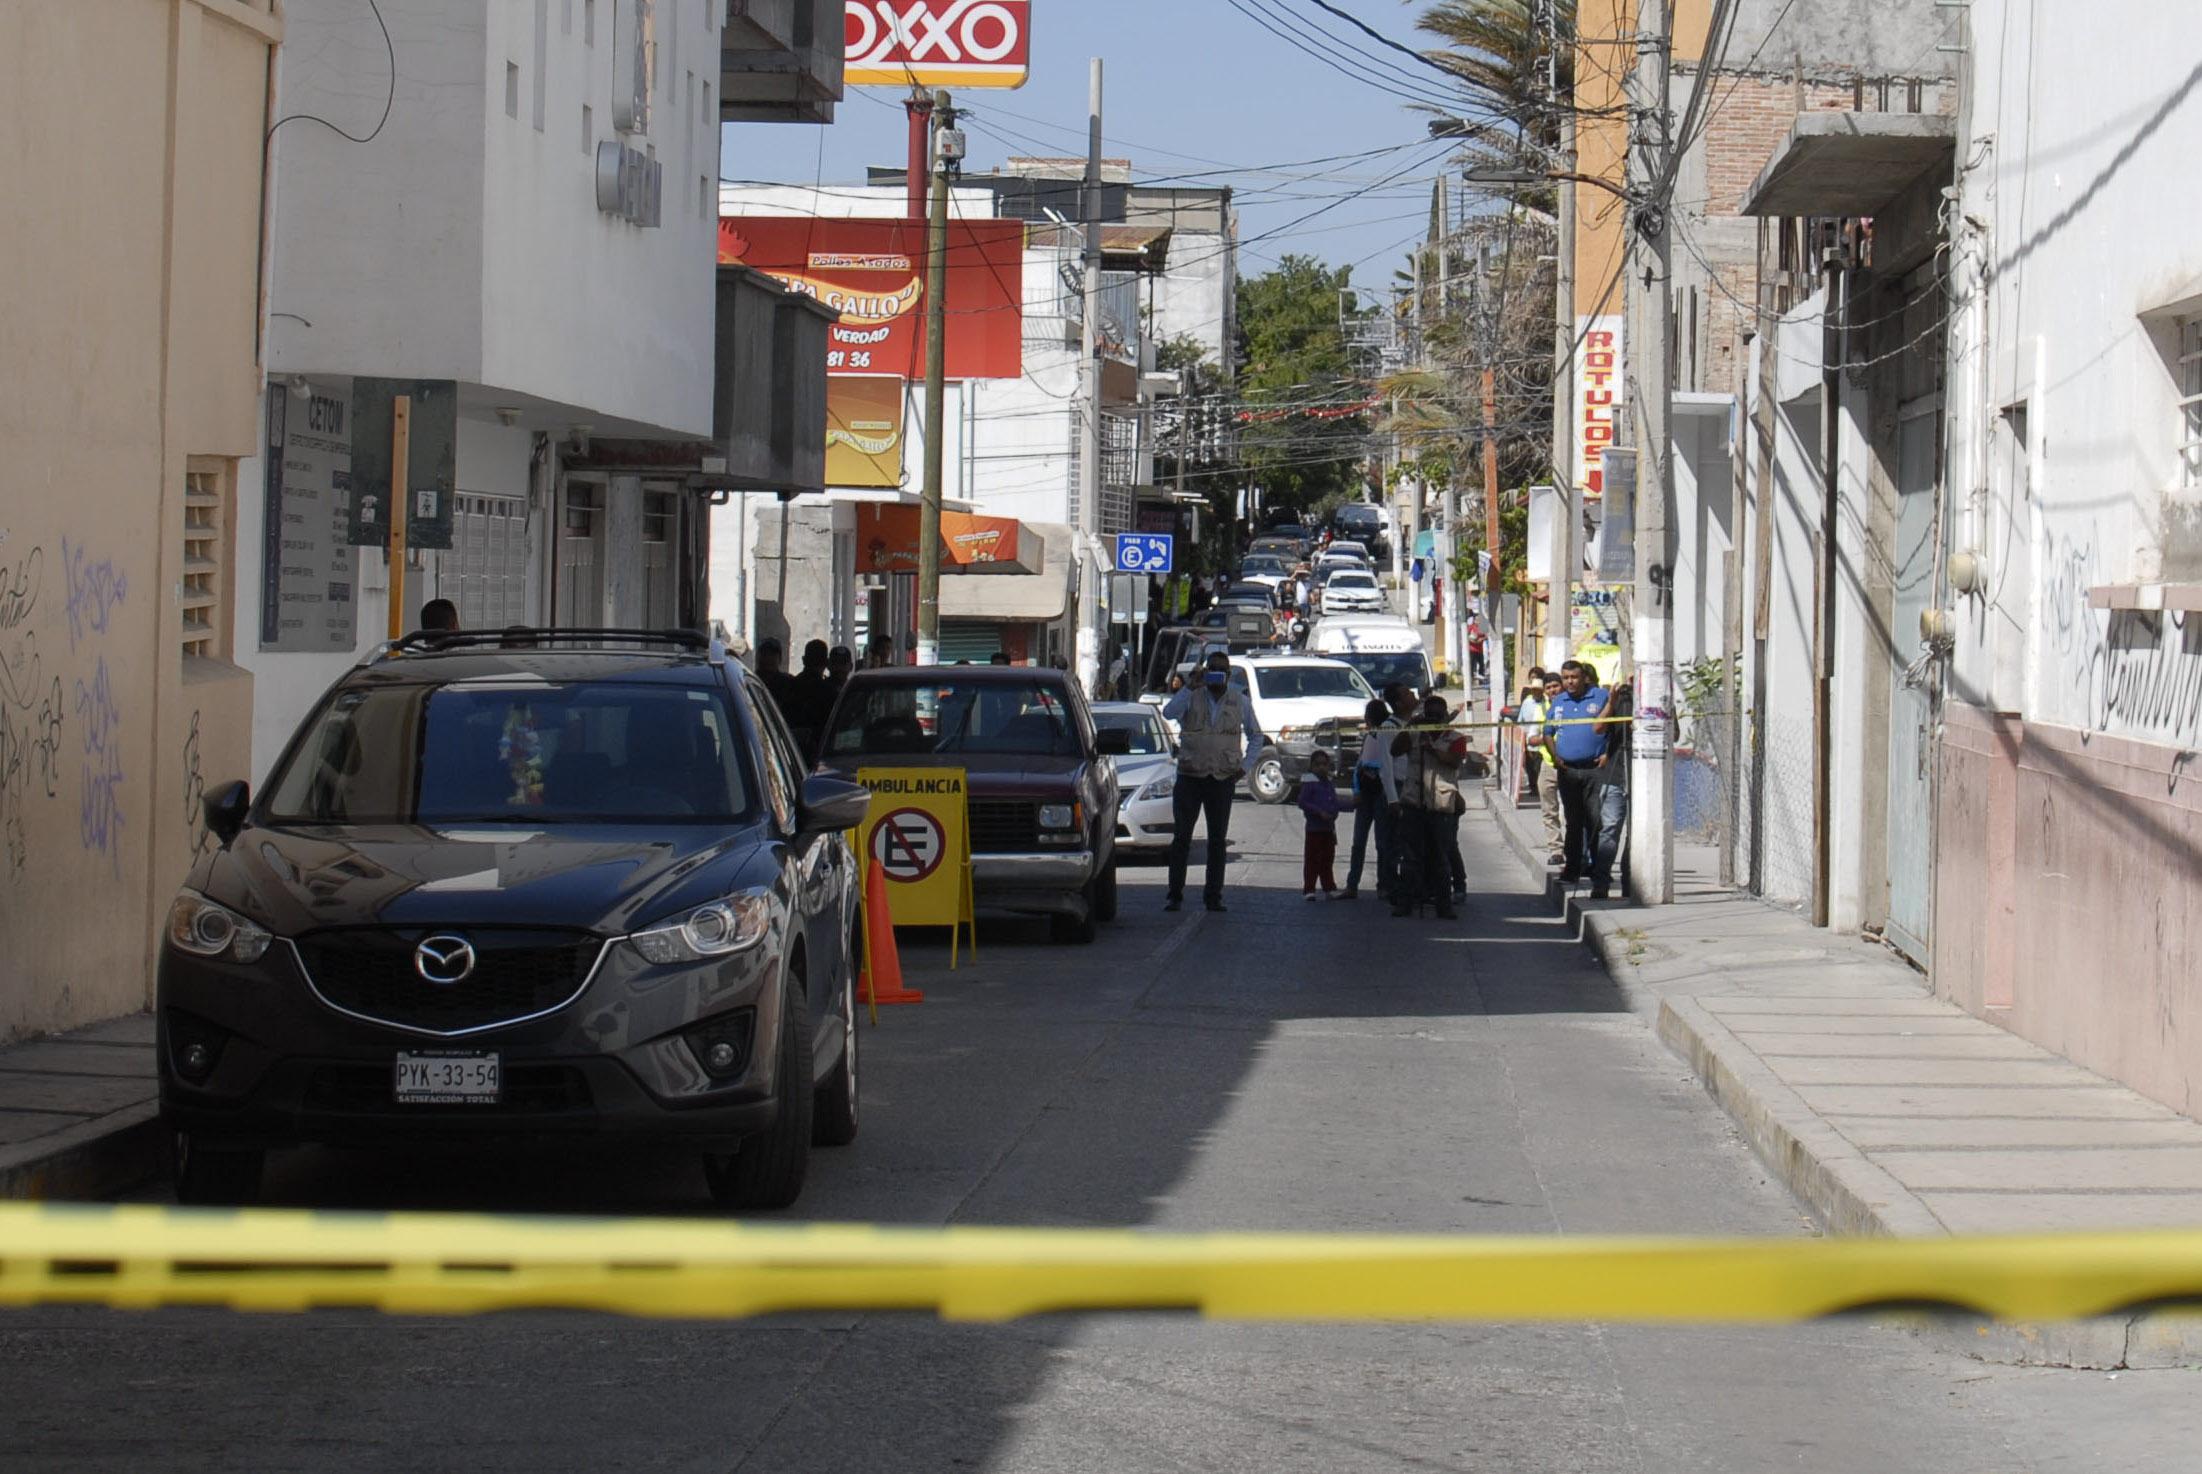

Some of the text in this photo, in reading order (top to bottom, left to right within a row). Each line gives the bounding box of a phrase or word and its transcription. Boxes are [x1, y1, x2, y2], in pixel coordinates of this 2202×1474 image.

[812, 256, 852, 266] Pollos
[833, 327, 890, 344] VERDAD
[827, 351, 870, 367] 81 36
[860, 779, 961, 793] AMBULANCIA
[398, 1063, 497, 1086] PYK-33-54
